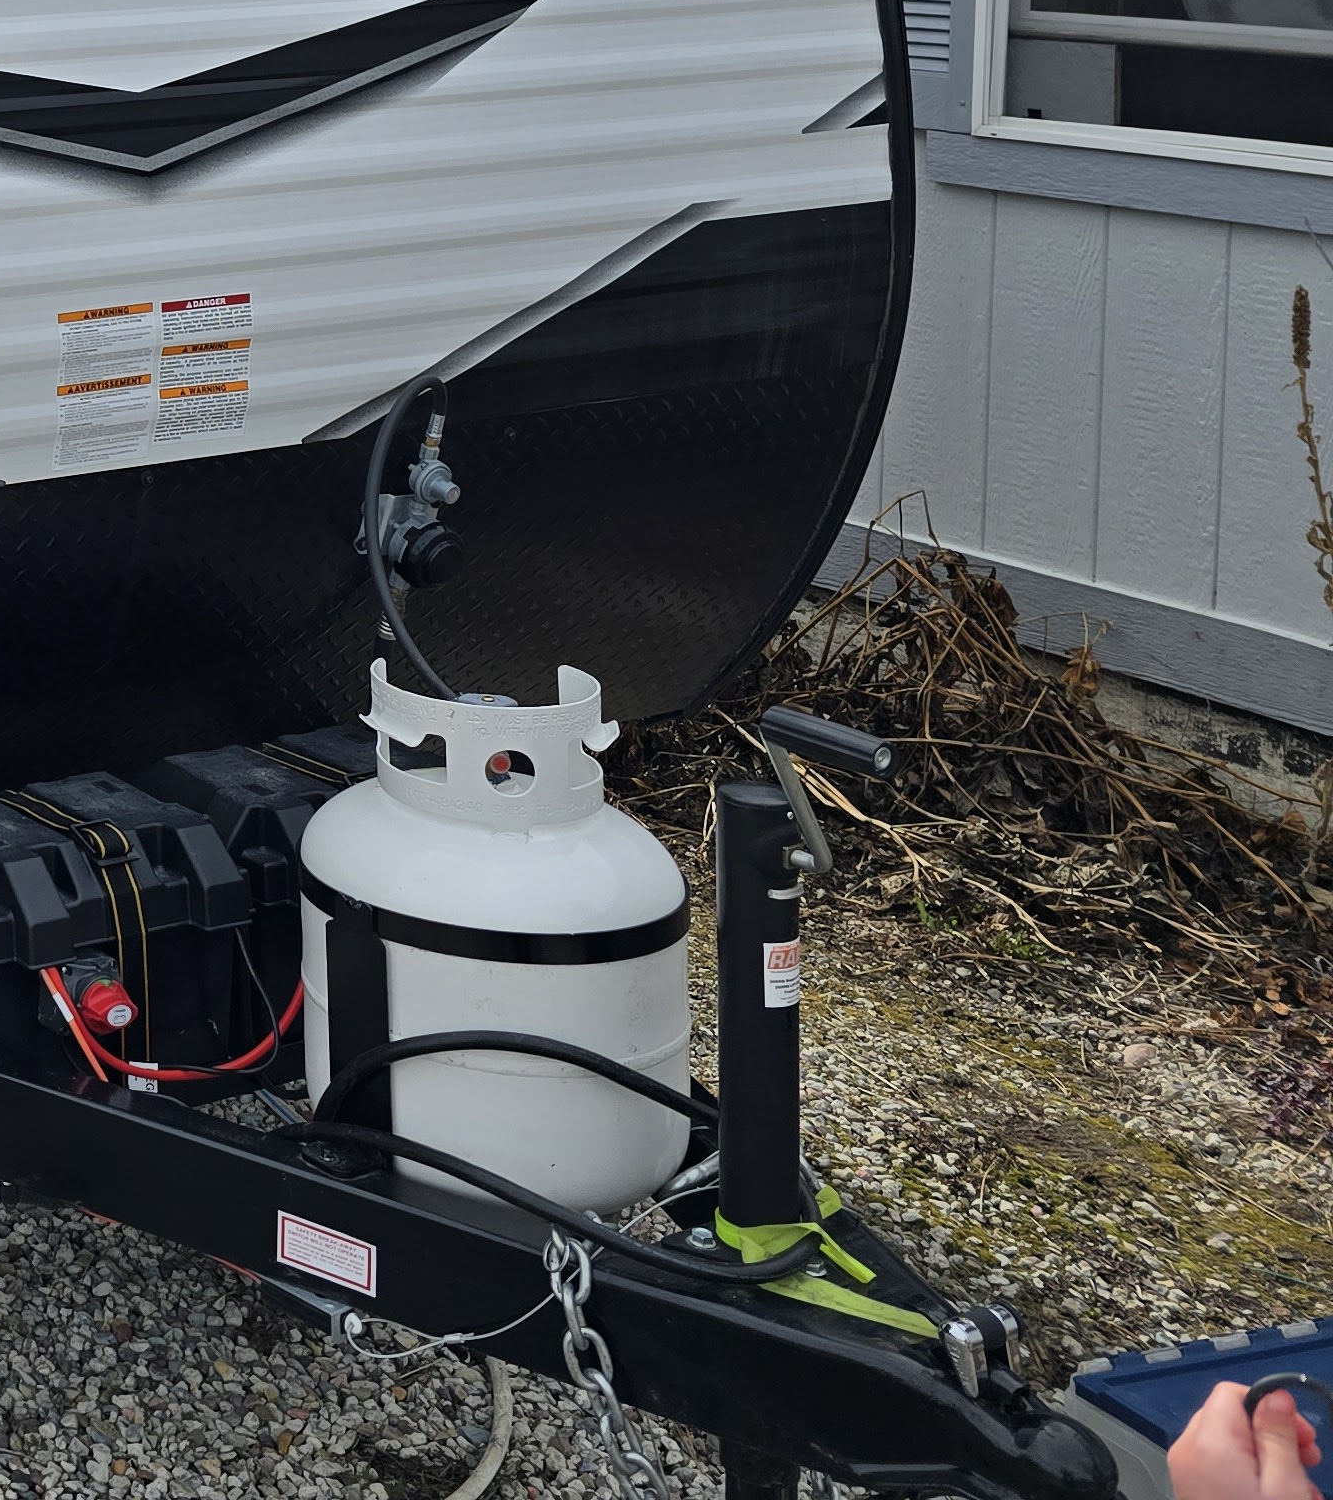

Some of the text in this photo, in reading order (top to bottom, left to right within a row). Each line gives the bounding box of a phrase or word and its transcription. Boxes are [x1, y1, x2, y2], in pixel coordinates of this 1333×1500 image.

[193, 297, 227, 308] DANGER
[90, 307, 130, 319] WARNING
[192, 342, 229, 353] WARNING
[74, 376, 143, 393] AVERTISSEMENT
[189, 384, 227, 395] WARNING
[769, 947, 800, 969] RA
[295, 1226, 317, 1239] SAFETY
[287, 1228, 365, 1261] SWITCH WILL NOT OPERATE
